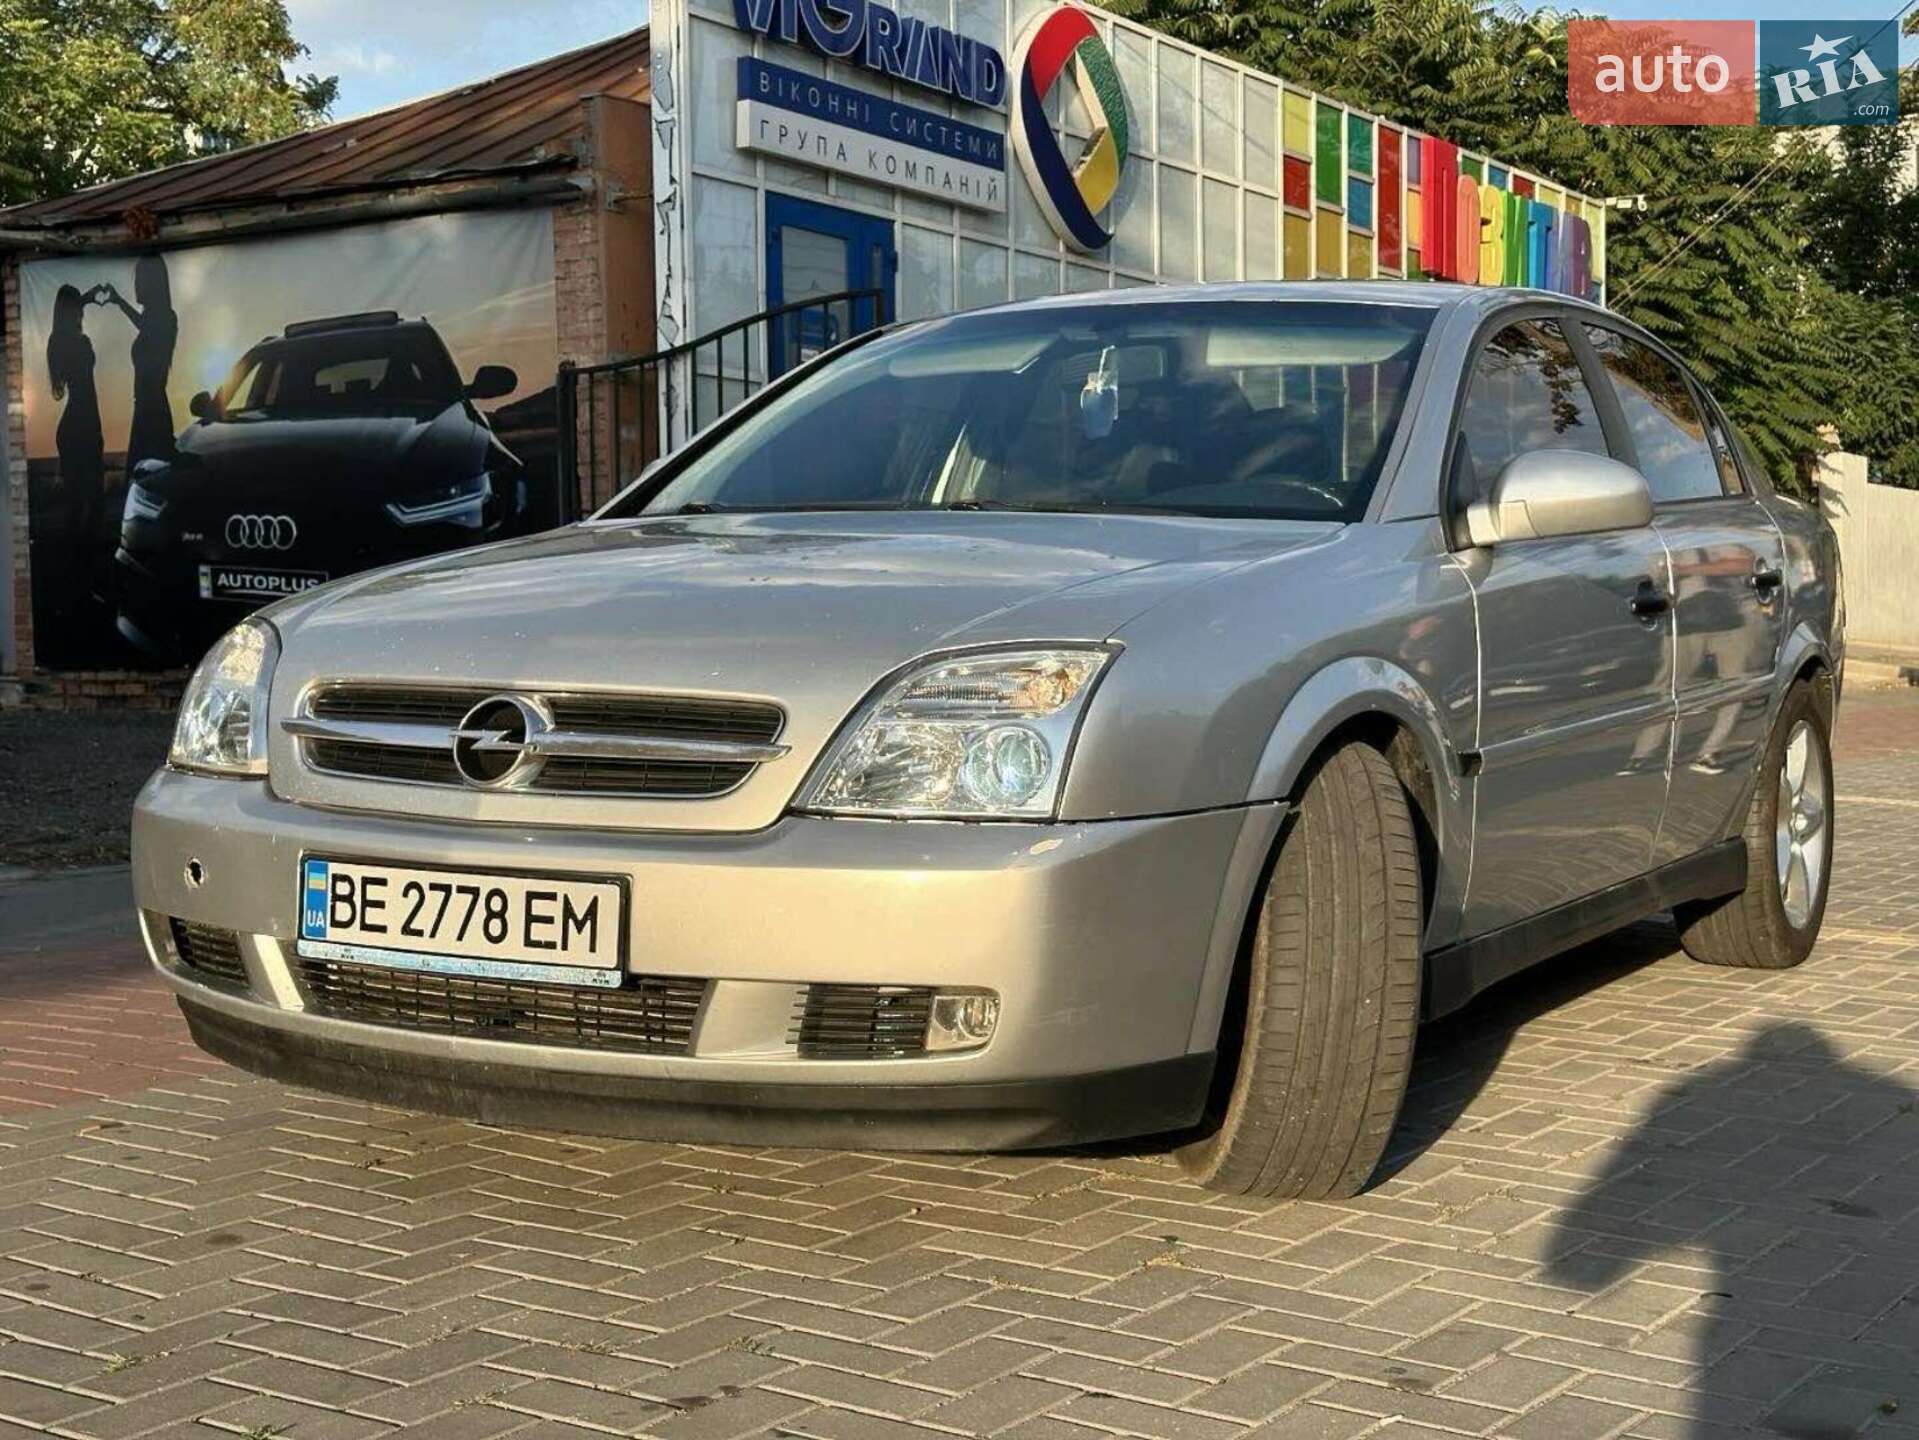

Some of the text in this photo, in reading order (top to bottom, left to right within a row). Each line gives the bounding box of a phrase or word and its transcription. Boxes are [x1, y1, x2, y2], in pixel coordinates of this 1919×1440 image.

[759, 70, 998, 160] ВІКОННІ СИСТЕМИ
[759, 118, 998, 202] ГРУПА КОМПАНІЙ
[217, 573, 319, 592] AUTOPLUS
[306, 909, 326, 930] UA
[330, 873, 599, 953] BE 2778 EM
